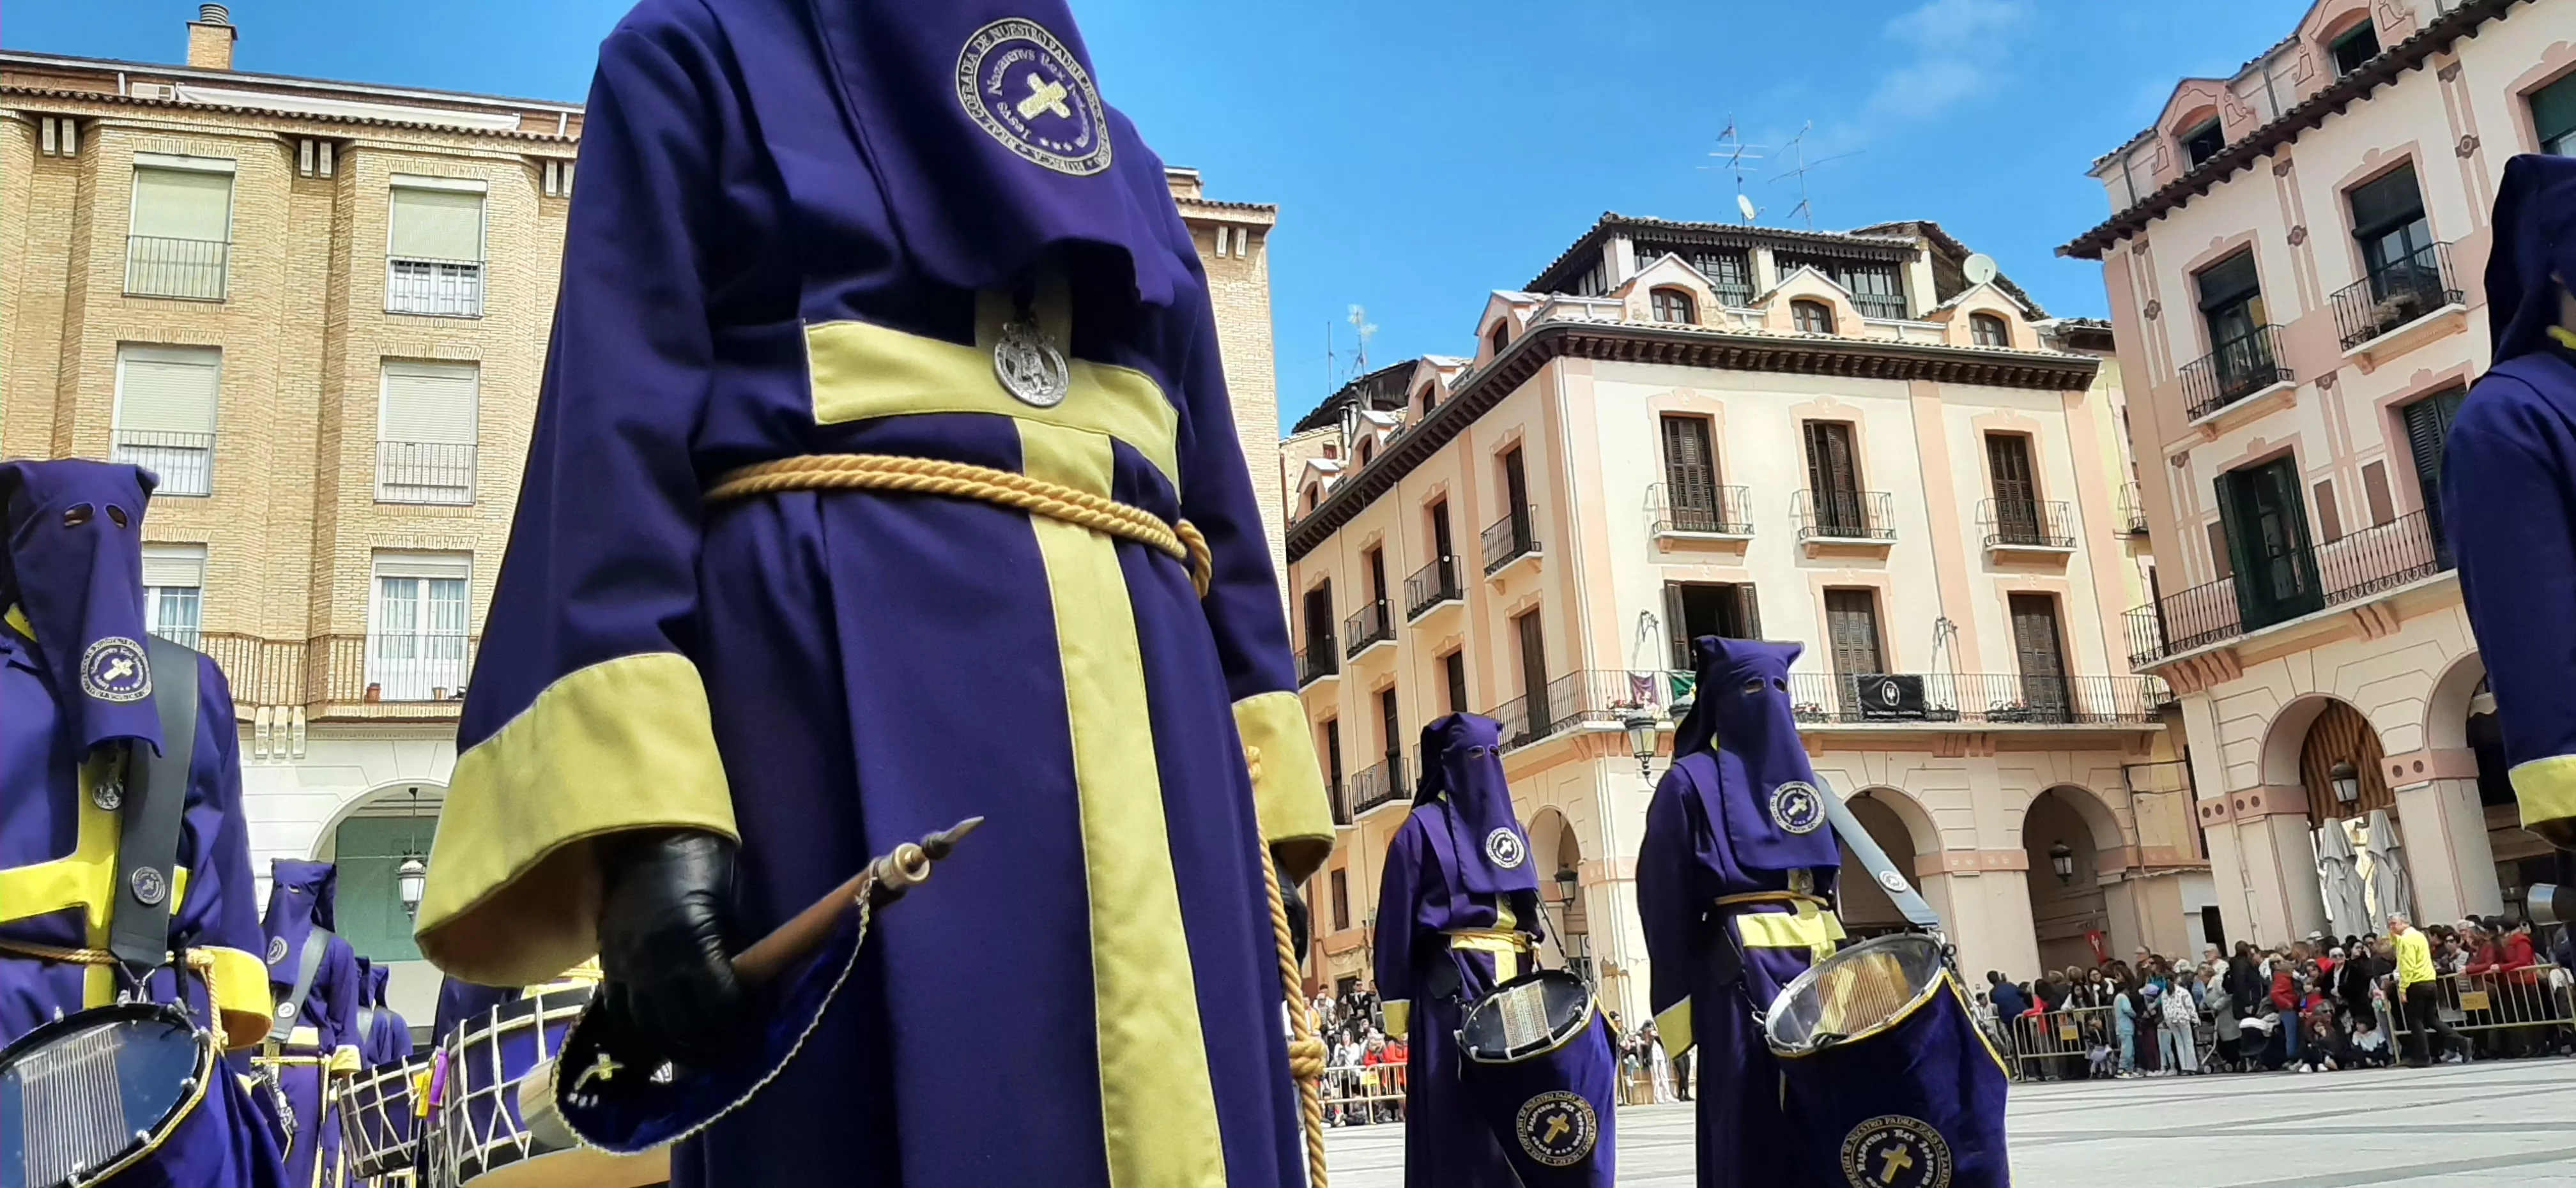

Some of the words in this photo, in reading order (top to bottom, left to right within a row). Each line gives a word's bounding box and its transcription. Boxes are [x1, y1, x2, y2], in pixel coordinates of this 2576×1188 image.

[989, 23, 1046, 46] NUESTRO
[1048, 40, 1084, 80] PADRE
[1885, 1118, 1916, 1128] PADRE
